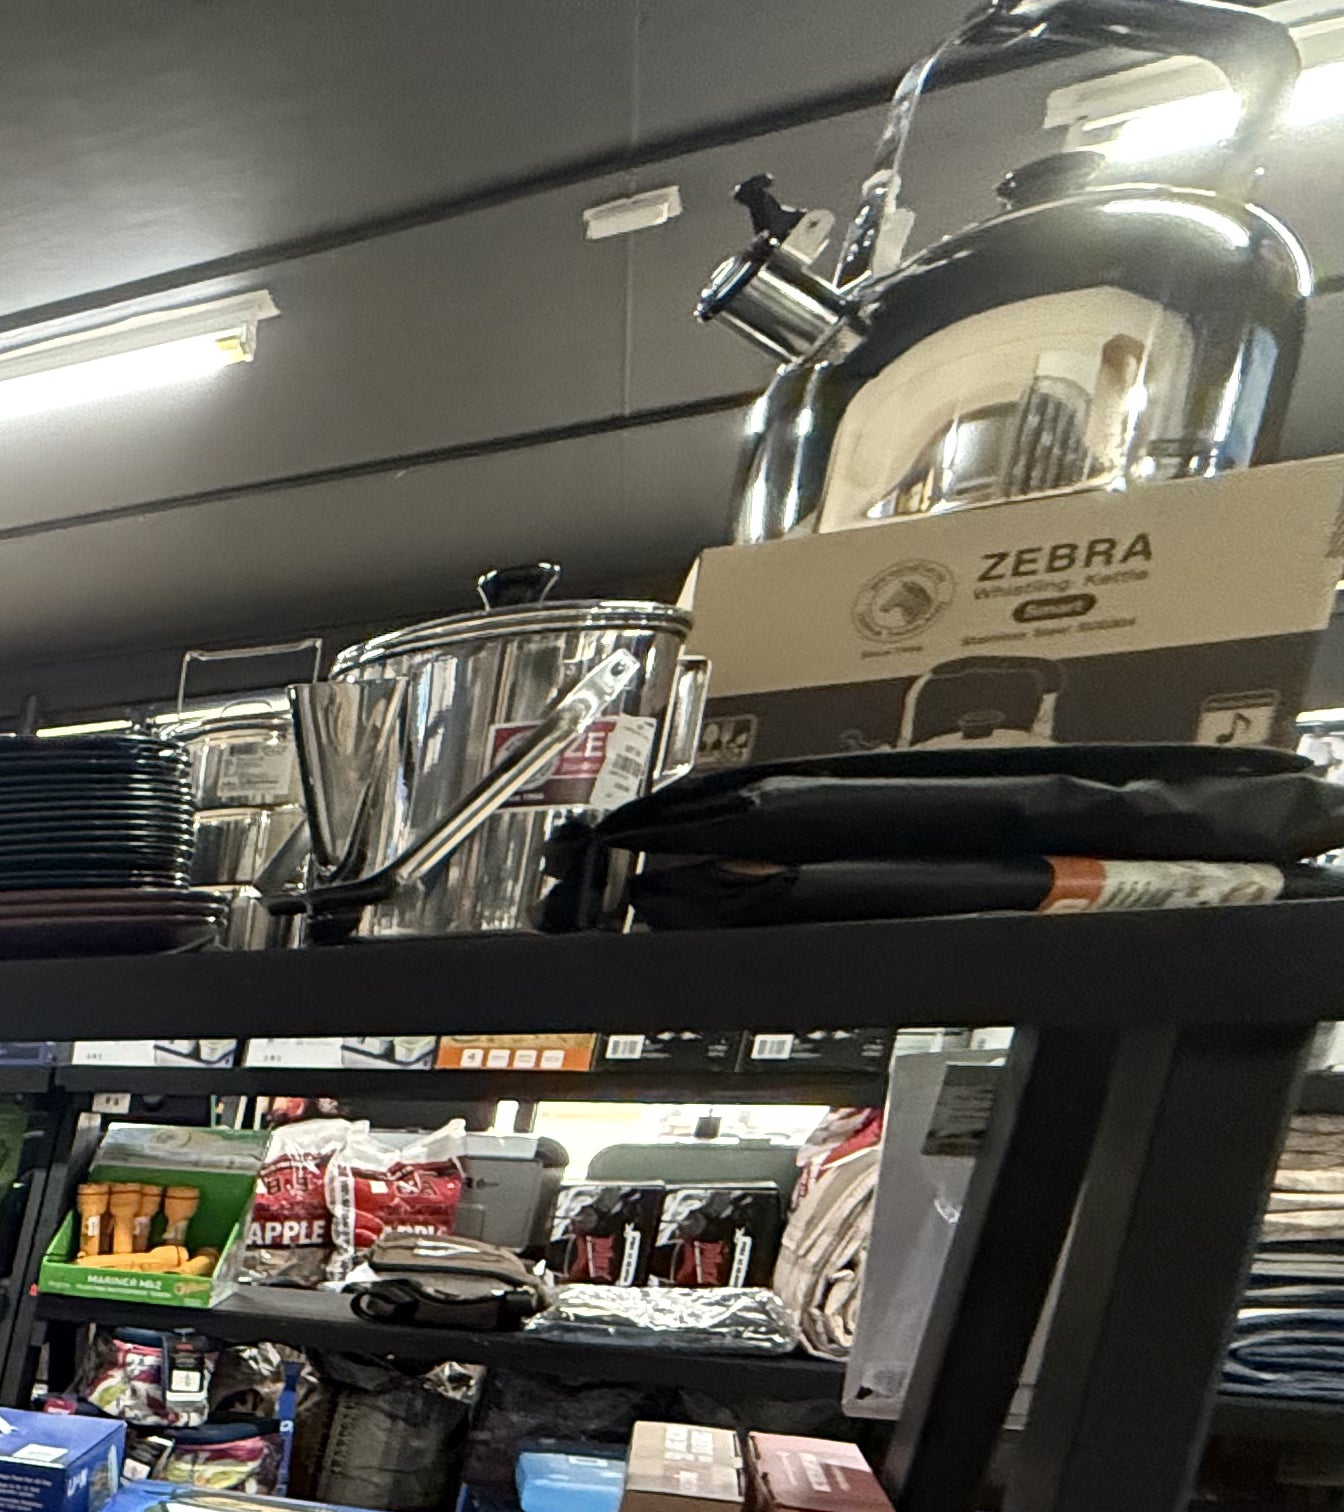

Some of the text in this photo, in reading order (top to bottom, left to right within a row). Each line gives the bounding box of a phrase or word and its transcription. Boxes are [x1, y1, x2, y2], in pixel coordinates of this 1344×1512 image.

[977, 532, 1153, 582] ZEBRA
[246, 1221, 326, 1246] APPLE
[88, 1274, 137, 1287] MARINER
